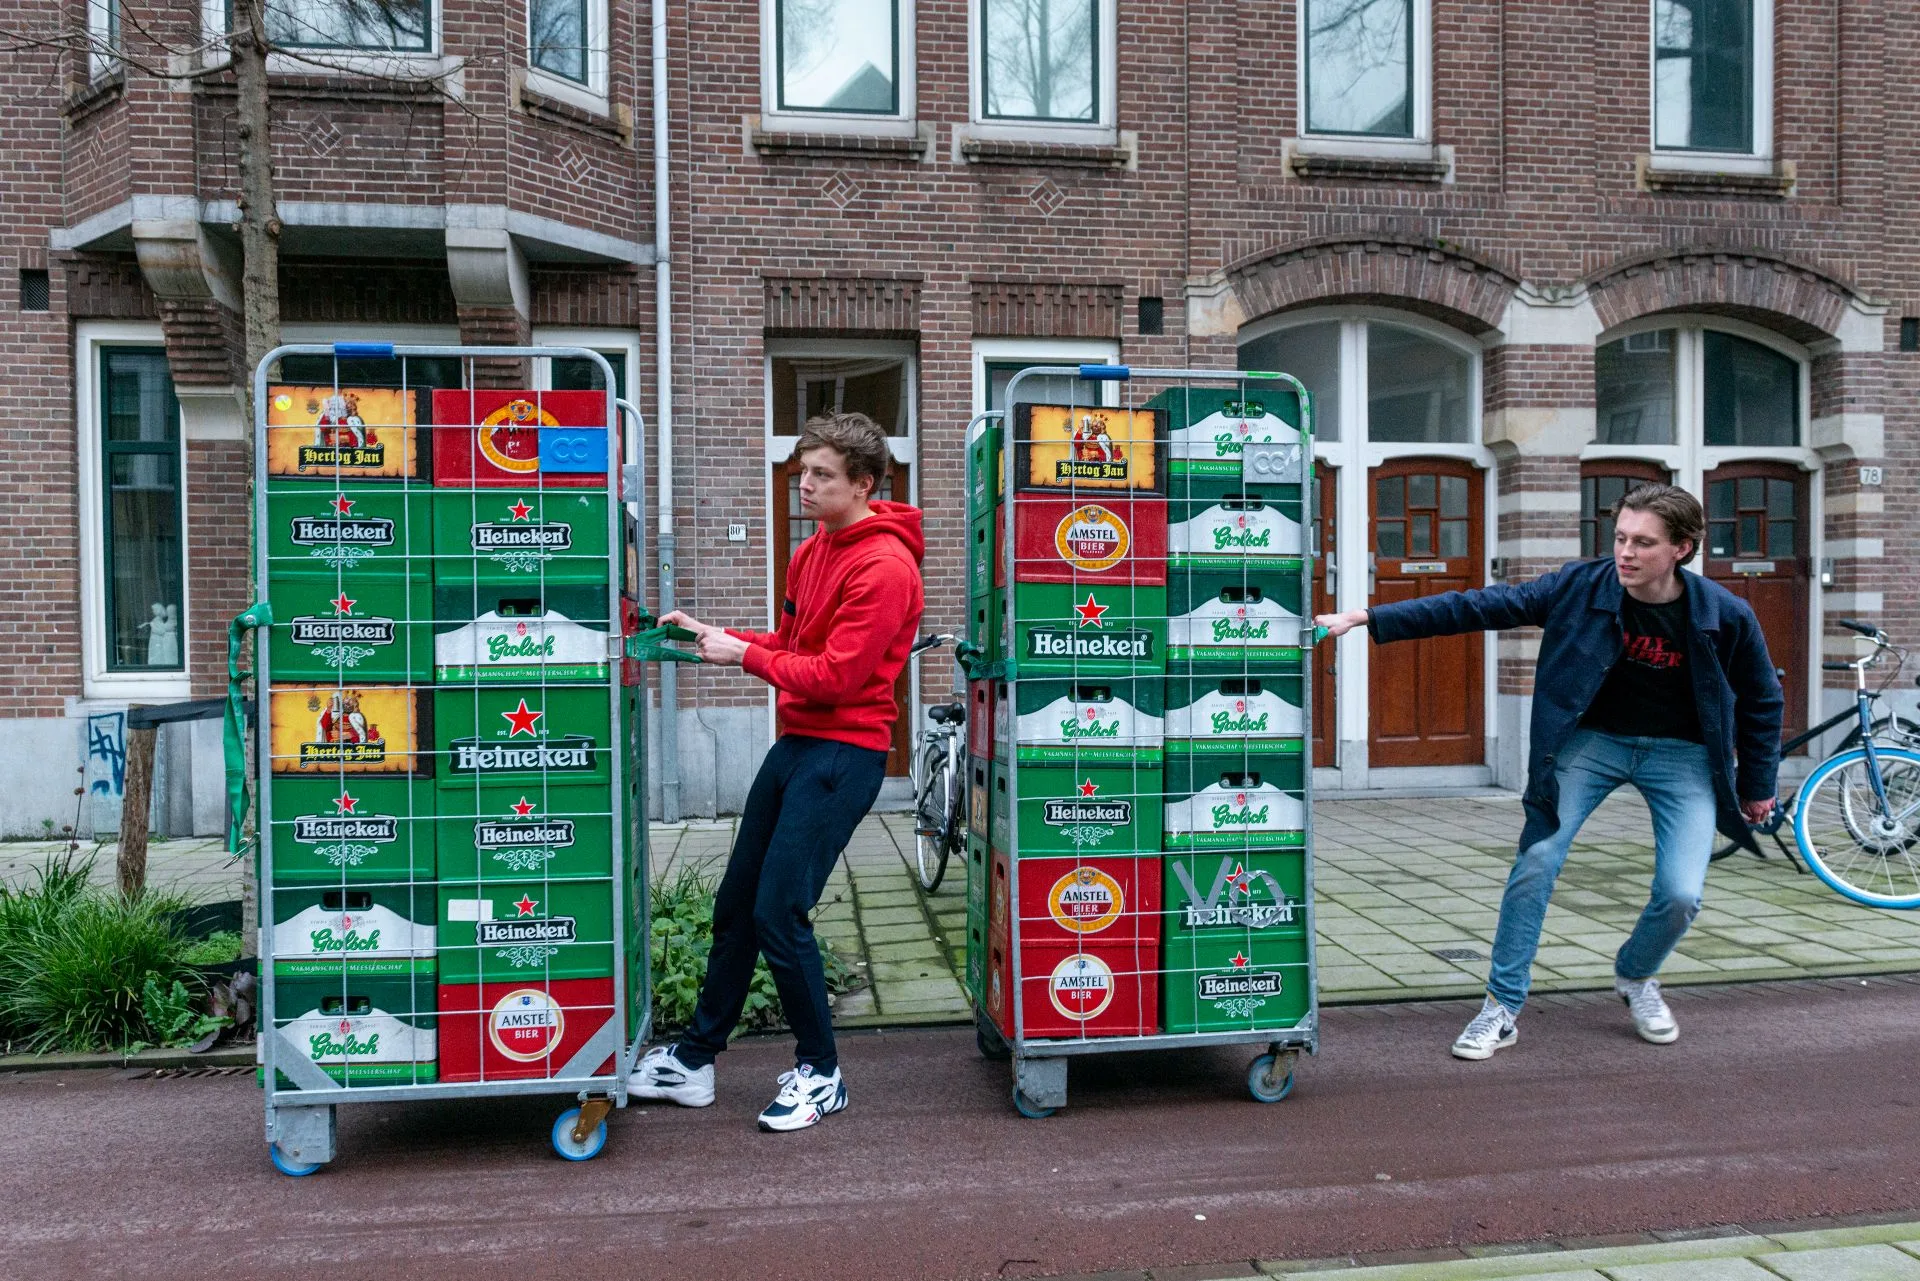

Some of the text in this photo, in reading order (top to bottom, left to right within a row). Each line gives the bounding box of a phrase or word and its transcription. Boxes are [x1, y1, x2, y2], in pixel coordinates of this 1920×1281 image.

[354, 449, 380, 464] Jan
[1061, 462, 1125, 477] Hertog Jan
[1863, 469, 1879, 482] 78
[299, 523, 387, 539] Heineken
[479, 528, 565, 544] Heineken
[731, 525, 740, 536] 80
[1070, 529, 1116, 540] AMSTEL
[1213, 526, 1271, 551] Grolsch
[1080, 541, 1105, 551] BIER
[299, 623, 387, 640] Heineken
[1212, 617, 1269, 643] Grolsch
[487, 634, 556, 661] Grolsch
[1034, 633, 1147, 657] Heineken
[1060, 718, 1120, 743] Grolsch
[1211, 710, 1269, 735] Grolsch
[305, 745, 381, 761] Hertog Jan
[458, 745, 589, 769] Heineken
[1051, 805, 1124, 819] Heineken
[1212, 803, 1269, 828] Grolsch
[301, 821, 390, 837] Heineken
[482, 827, 568, 843] Heineken
[1063, 890, 1109, 902] AMSTEL
[1073, 904, 1099, 913] BIER
[484, 923, 569, 941] Heineken
[310, 928, 381, 954] Grolsch
[1060, 976, 1104, 988] AMSTEL
[1205, 977, 1277, 994] Heineken
[1071, 991, 1092, 1000] BIER
[514, 1029, 539, 1039] BIER
[309, 1032, 380, 1060] Grolsch
